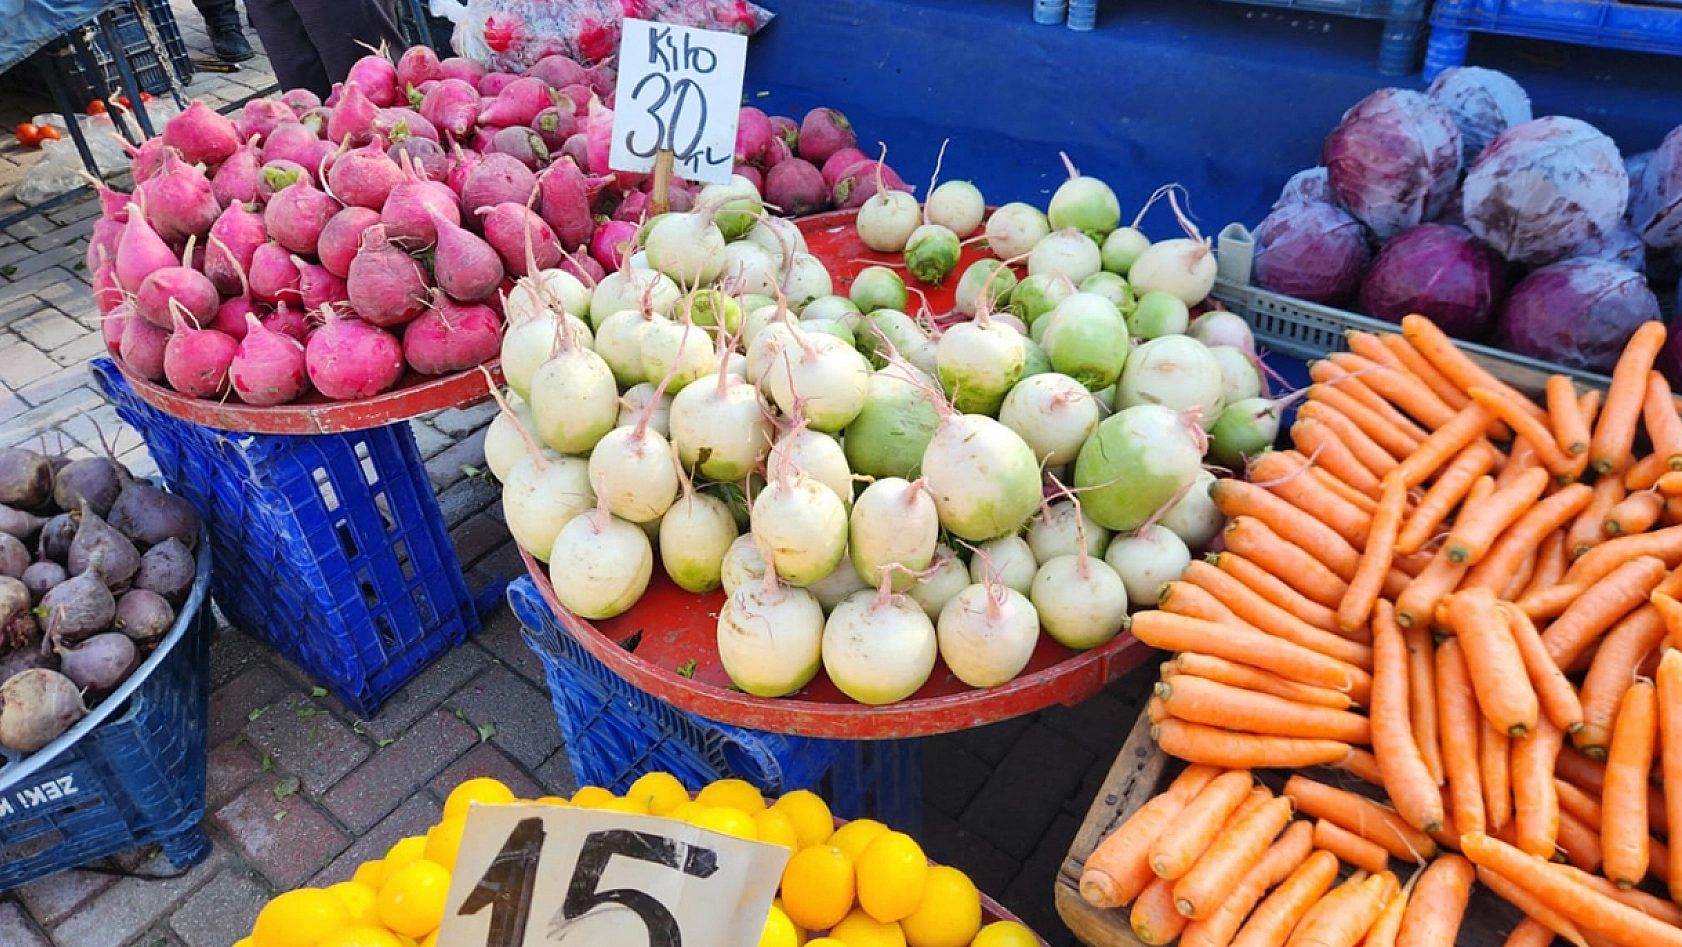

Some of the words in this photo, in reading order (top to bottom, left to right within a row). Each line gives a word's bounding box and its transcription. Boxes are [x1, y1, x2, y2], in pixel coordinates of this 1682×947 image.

[648, 26, 718, 74] Kilo
[625, 72, 708, 160] 30
[457, 816, 720, 947] 15
